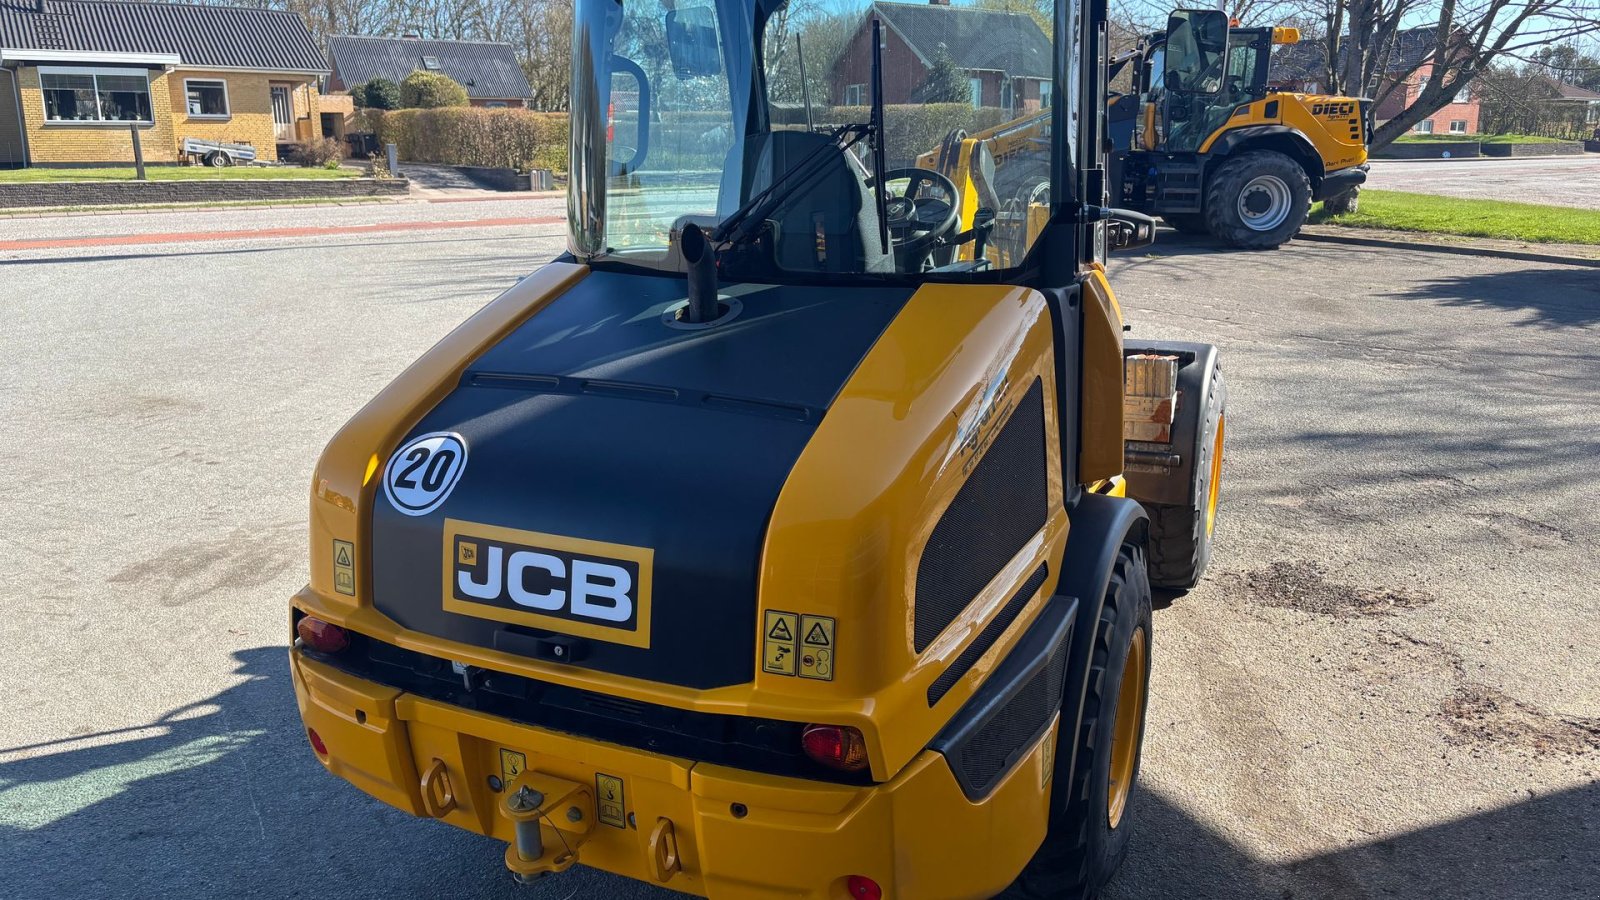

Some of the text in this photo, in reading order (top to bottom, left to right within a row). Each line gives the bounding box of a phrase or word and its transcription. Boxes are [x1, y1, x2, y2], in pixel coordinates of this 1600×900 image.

[1312, 103, 1354, 115] DIECI
[394, 447, 456, 492] 20
[458, 546, 632, 622] JCB
